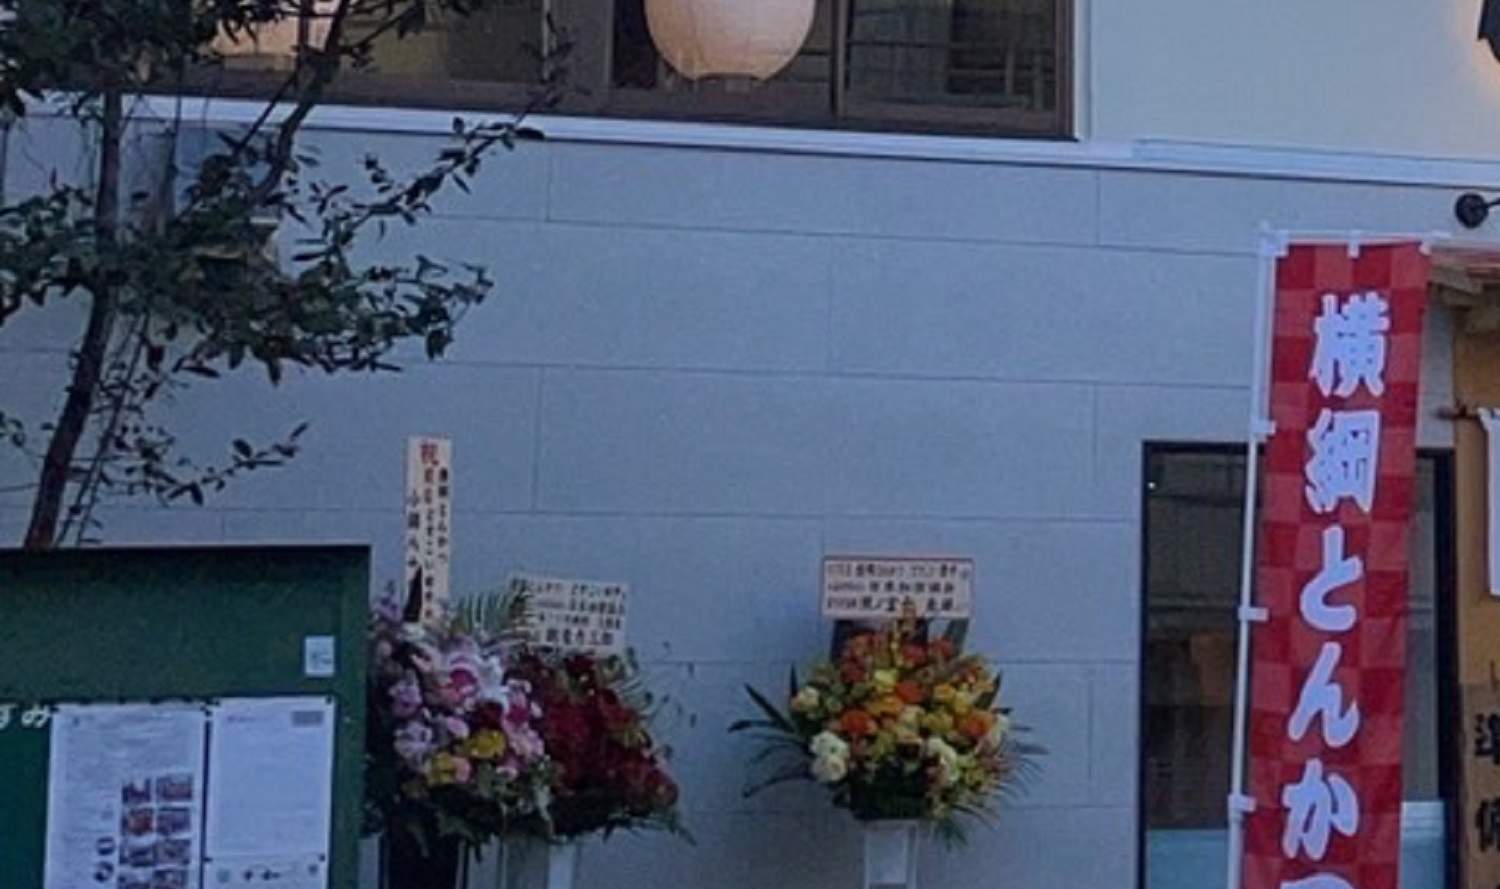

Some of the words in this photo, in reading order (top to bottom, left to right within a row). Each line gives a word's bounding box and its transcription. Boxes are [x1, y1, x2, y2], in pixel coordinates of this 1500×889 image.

[1280, 291, 1390, 889] 横綱とんか
